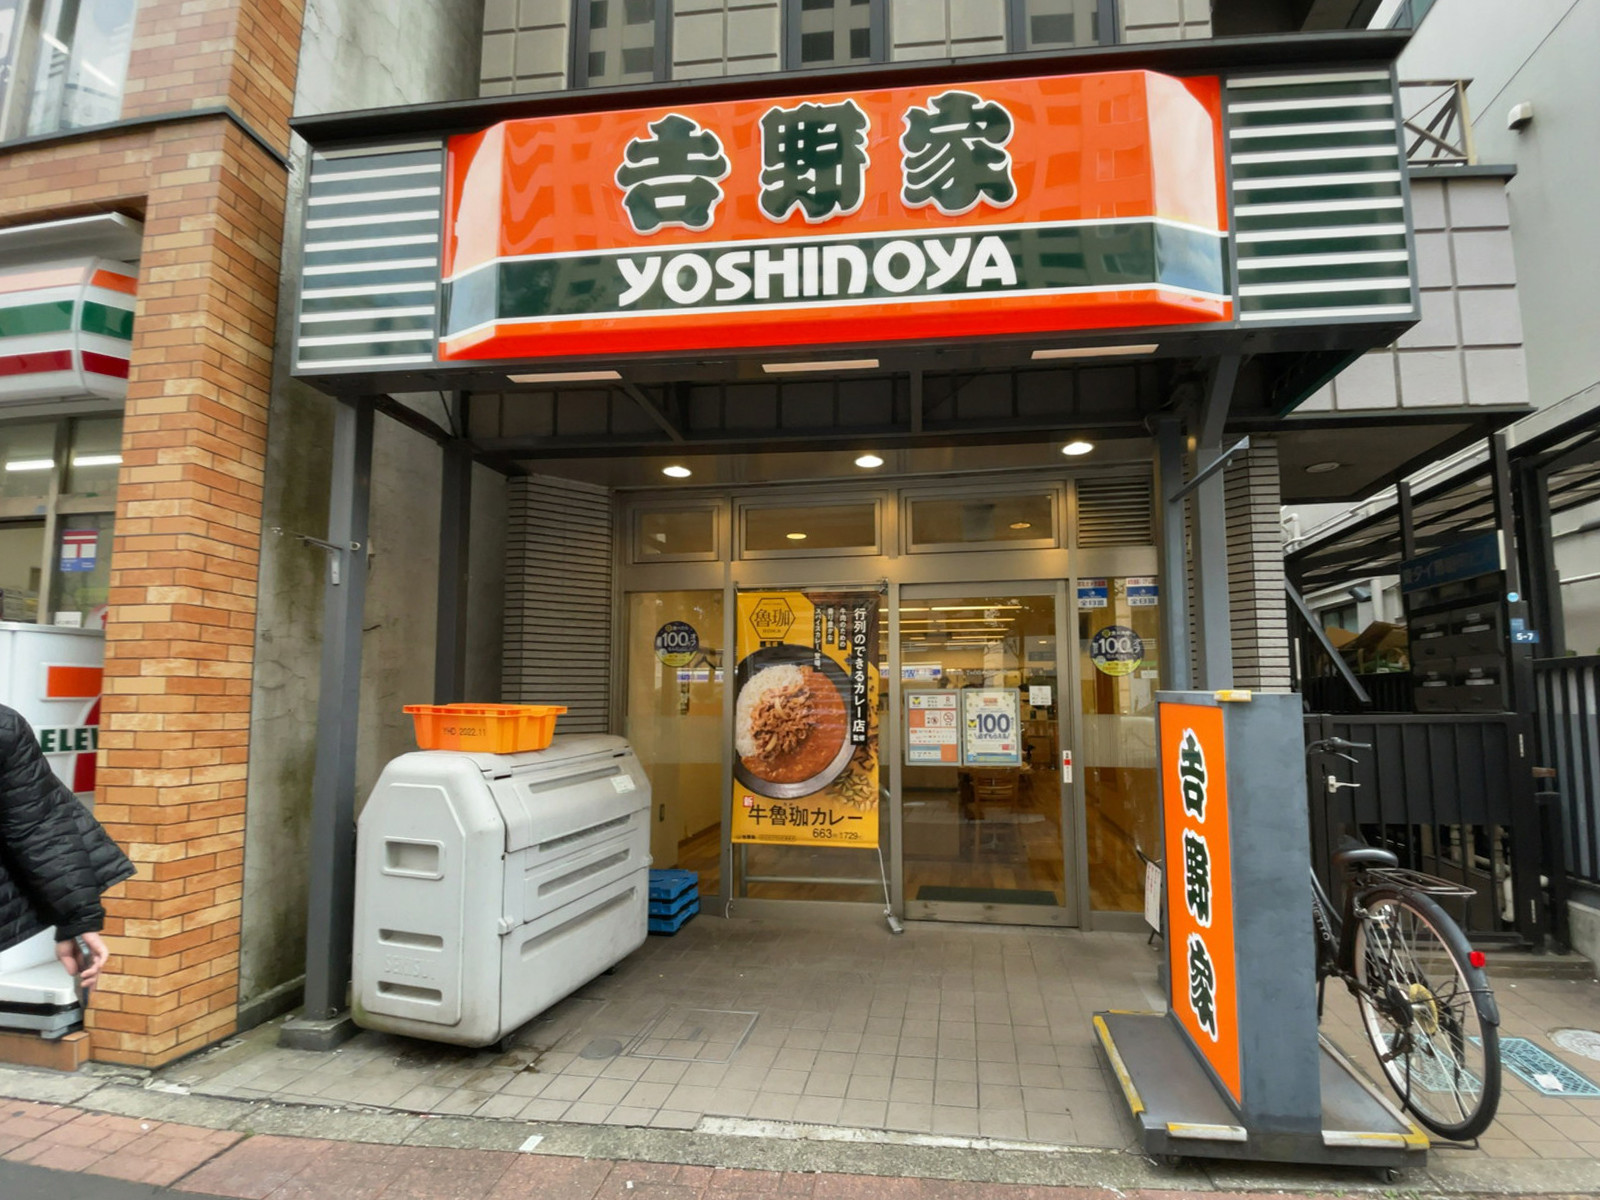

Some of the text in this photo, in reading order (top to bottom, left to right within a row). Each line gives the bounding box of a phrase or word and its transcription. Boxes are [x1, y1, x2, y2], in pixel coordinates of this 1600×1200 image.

[616, 235, 1018, 307] YOSHINOYA
[662, 631, 689, 647] 100
[1098, 637, 1131, 653] 100
[1516, 632, 1534, 641] 5-7
[852, 607, 867, 732] 行列のできるカレー店
[976, 713, 1011, 733] 100
[748, 804, 863, 827] 牛魯珈カレー
